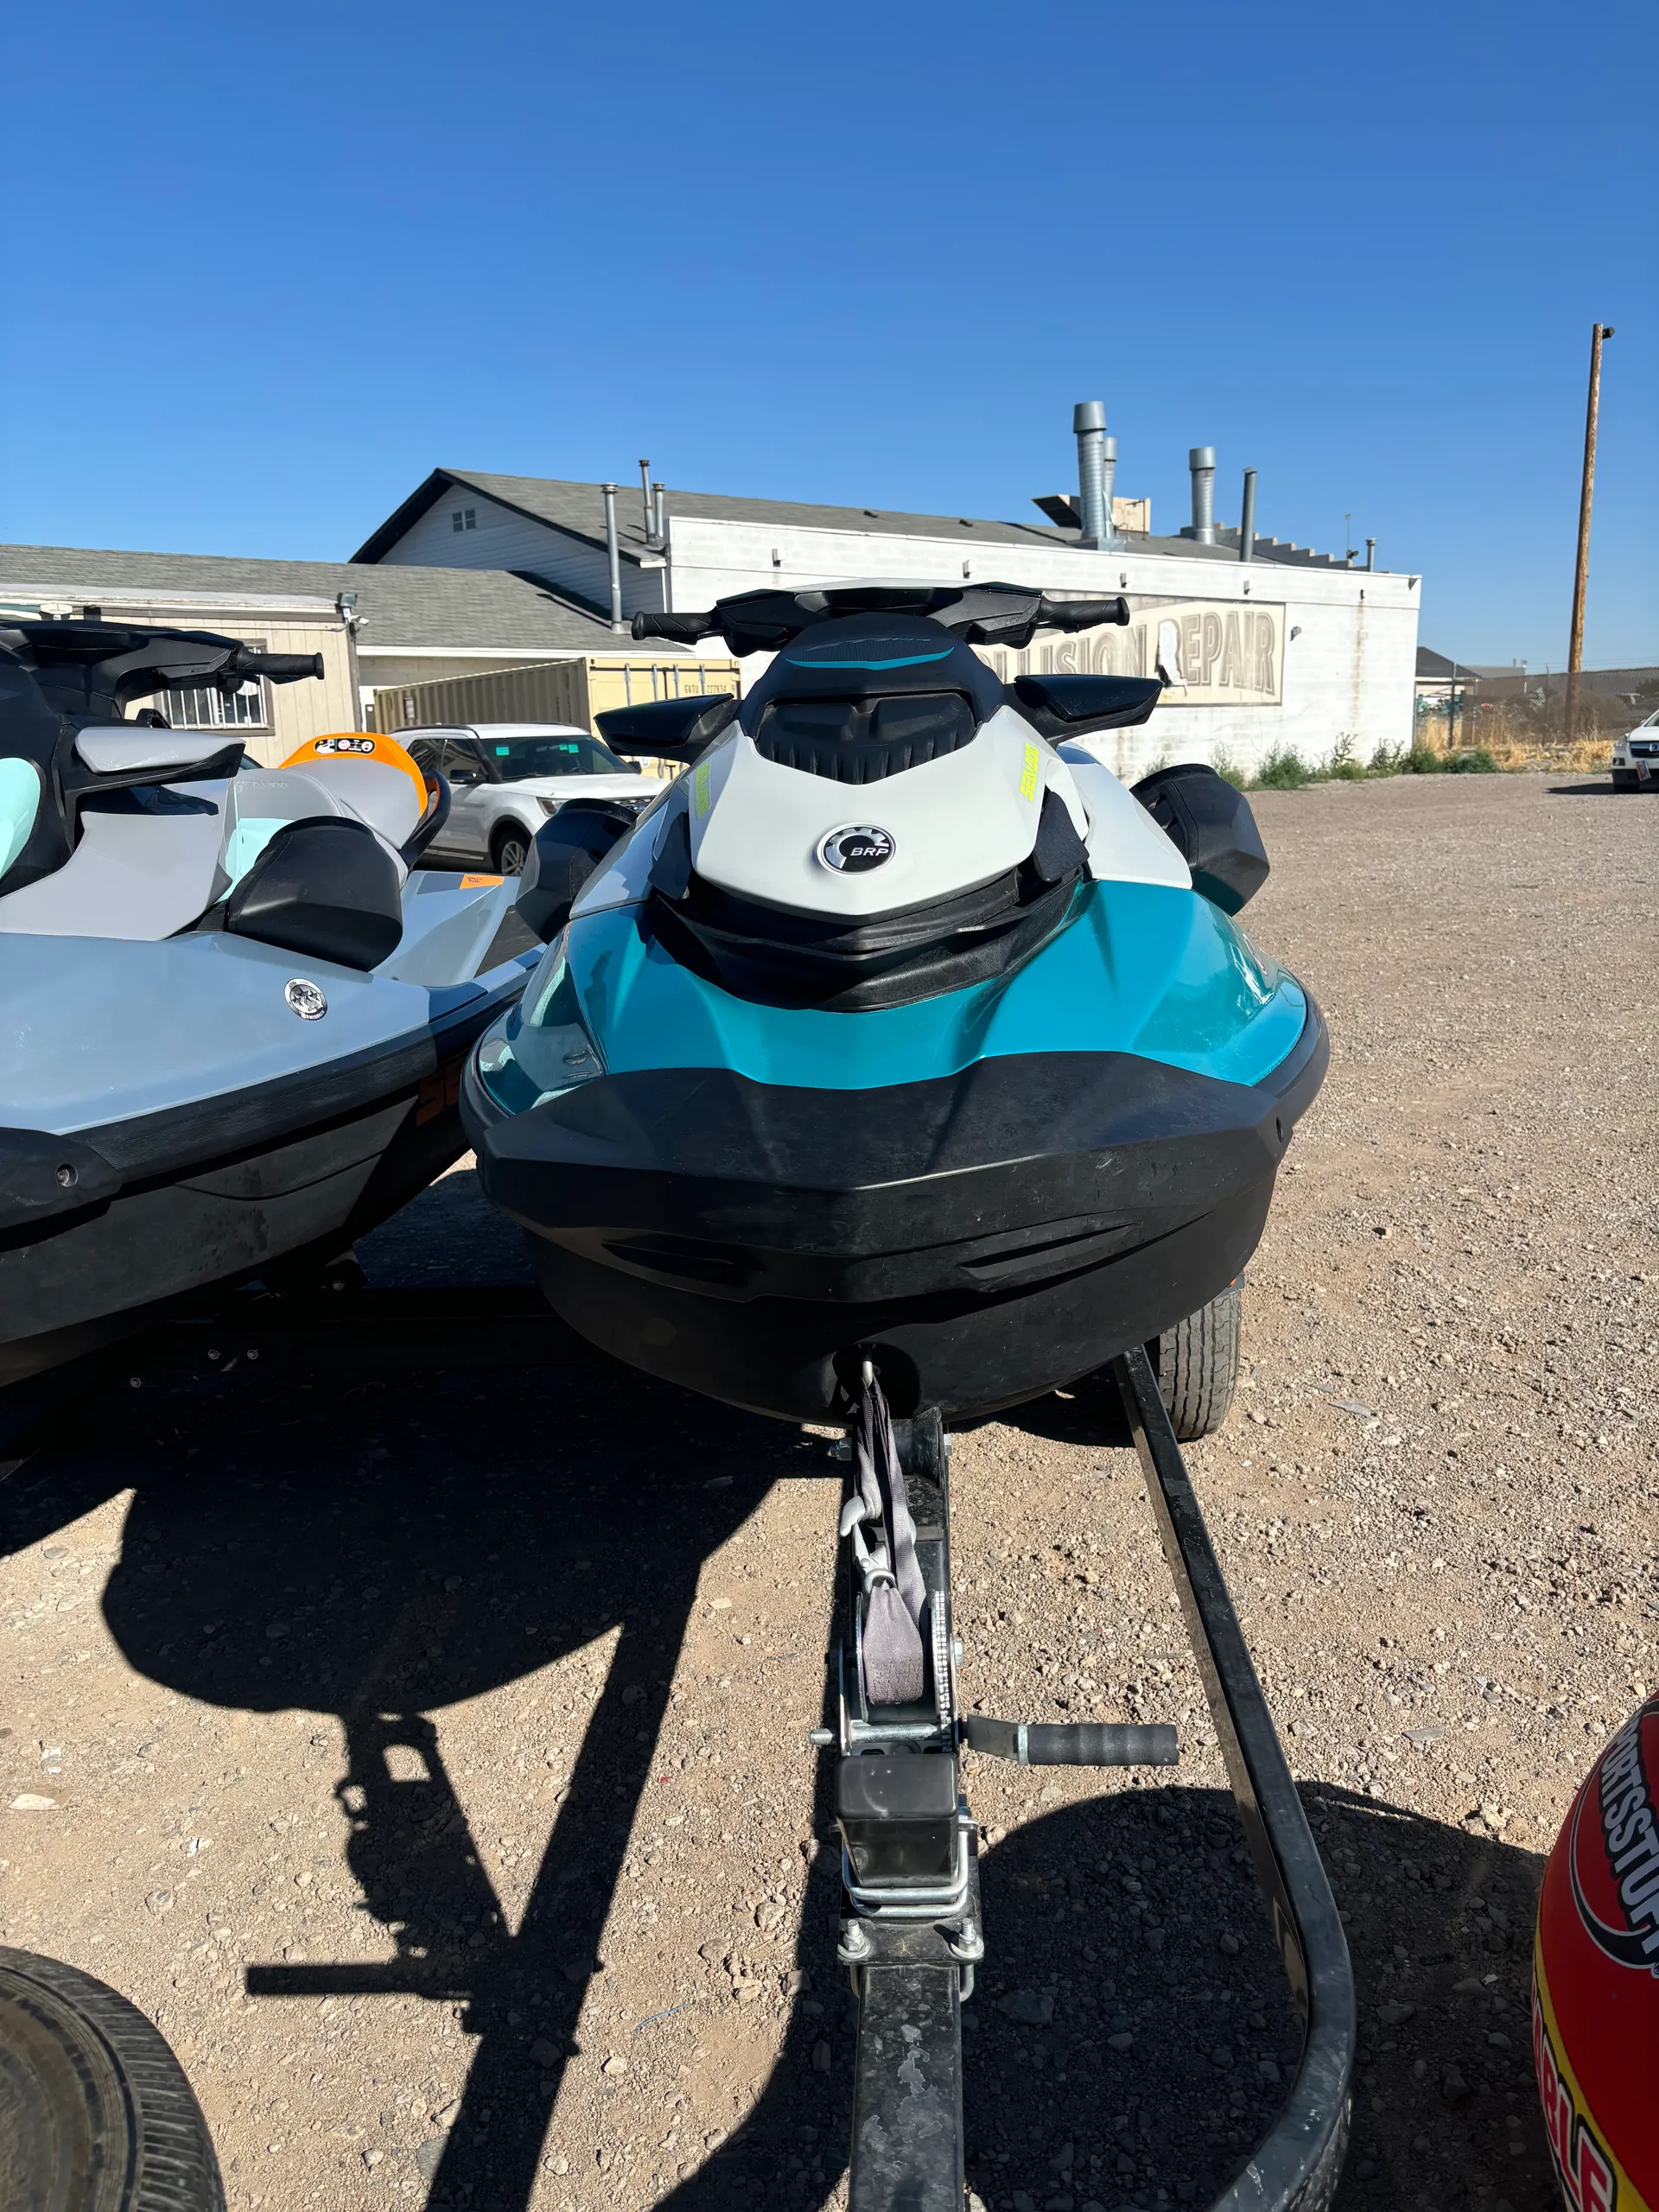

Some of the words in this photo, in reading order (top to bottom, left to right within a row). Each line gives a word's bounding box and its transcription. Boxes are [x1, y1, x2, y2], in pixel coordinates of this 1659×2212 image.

[976, 623, 1147, 683] LLISION
[1157, 610, 1275, 696] EPAIR
[849, 847, 889, 856] BRP
